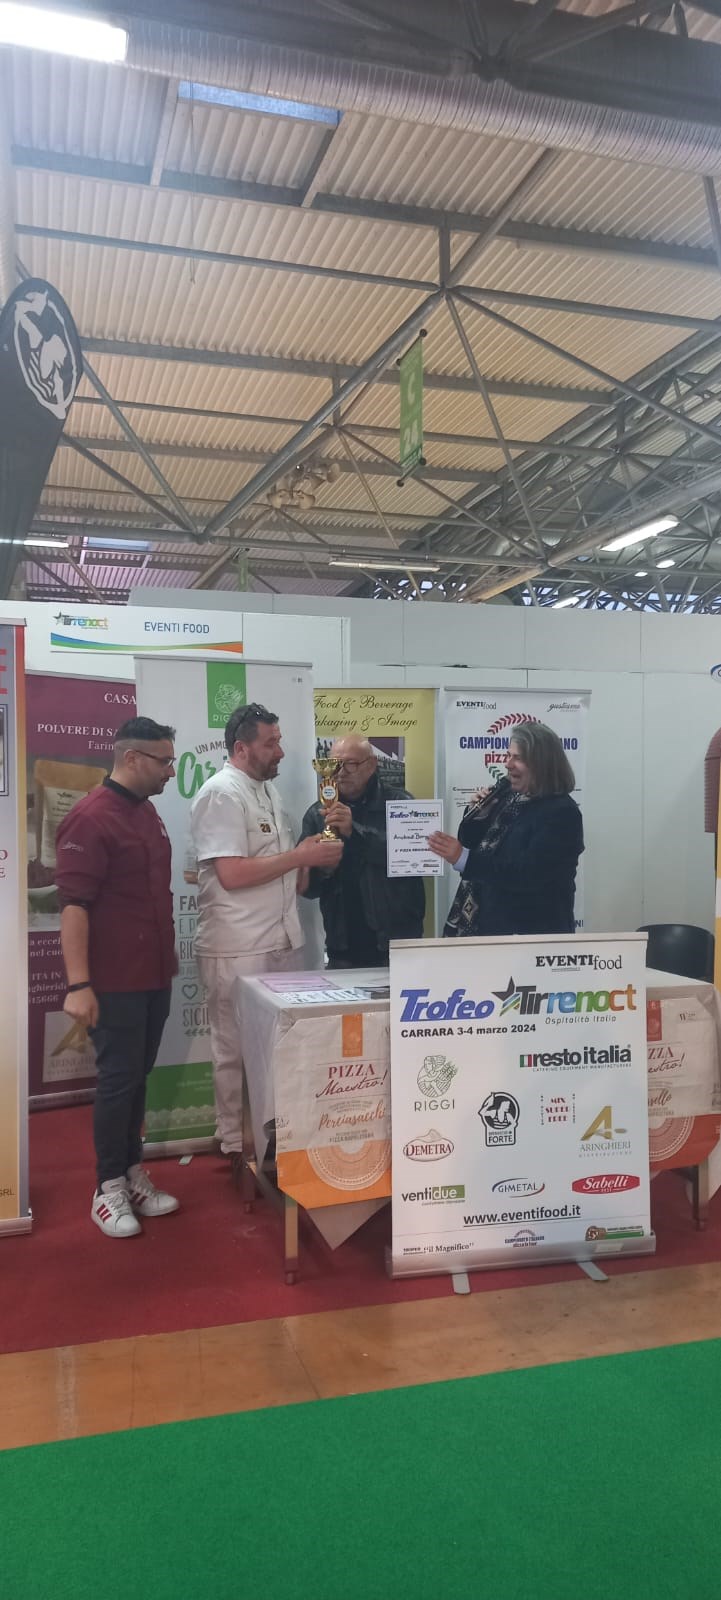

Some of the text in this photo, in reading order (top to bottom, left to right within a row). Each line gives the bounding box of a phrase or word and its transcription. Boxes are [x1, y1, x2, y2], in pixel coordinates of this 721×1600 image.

[144, 622, 210, 634] EVENTI FOOD
[104, 693, 137, 705] CASA
[314, 695, 414, 713] Food & Beverage
[378, 713, 418, 731] Image
[37, 723, 89, 736] POLVERE
[92, 727, 104, 737] DI
[195, 743, 209, 754] UN
[460, 736, 511, 750] CAMPION
[484, 751, 511, 768] pizz
[400, 983, 637, 1022] Trofeo Tirrenoct
[401, 1023, 536, 1038] CARRARA 3-4 marzo 2024
[328, 1064, 375, 1079] PIZZA
[315, 1069, 388, 1098] Maestro!
[414, 1099, 455, 1112] RIGGI
[488, 1135, 513, 1144] FORTE
[579, 1141, 631, 1152] ARINGHIERI
[405, 1143, 453, 1157] DEMETRA
[497, 1183, 538, 1193] GIMETAL
[582, 1175, 629, 1190] Sabelli
[401, 1186, 457, 1202] ventidue
[463, 1205, 581, 1225] www.eventifood.it
